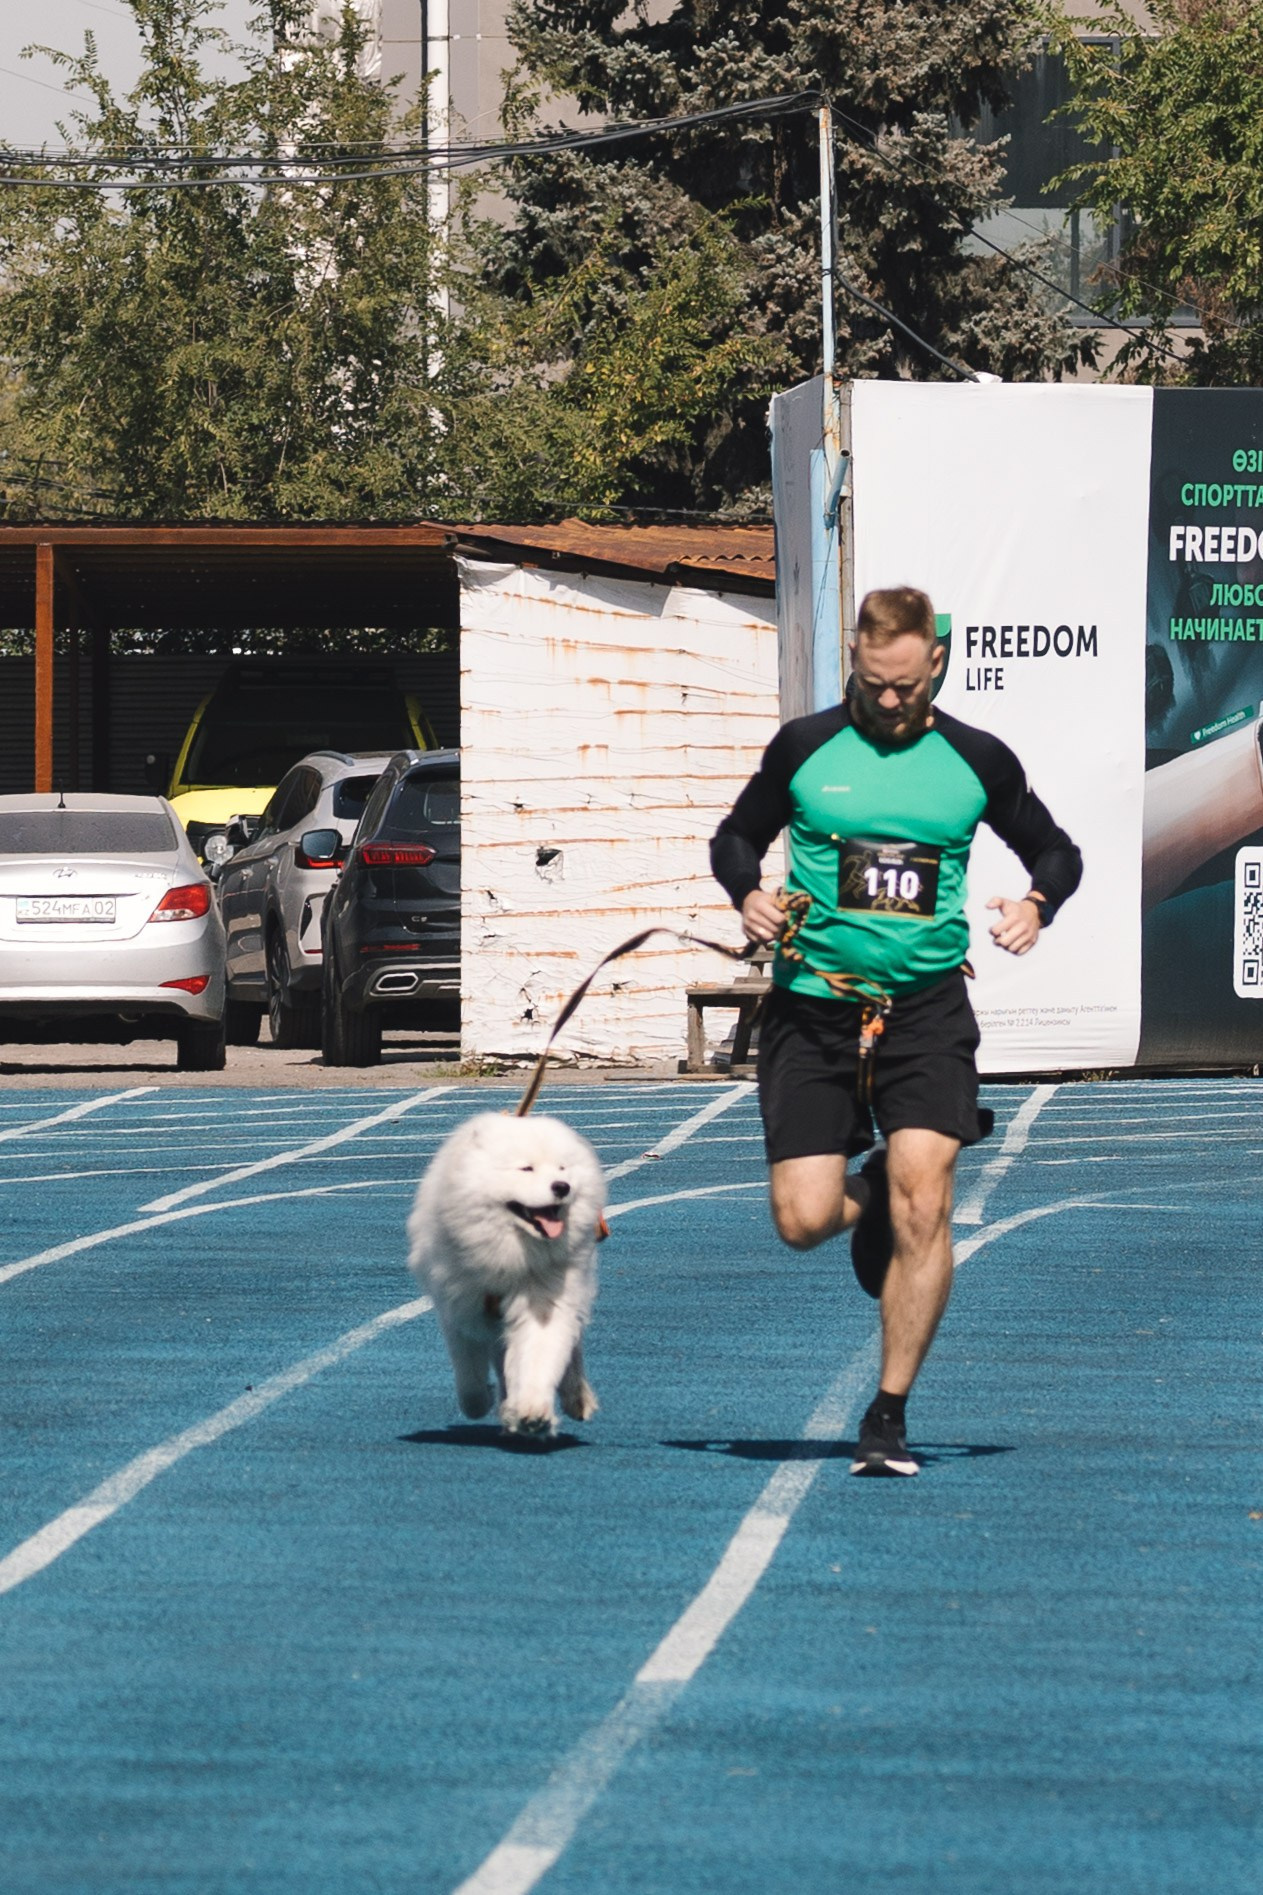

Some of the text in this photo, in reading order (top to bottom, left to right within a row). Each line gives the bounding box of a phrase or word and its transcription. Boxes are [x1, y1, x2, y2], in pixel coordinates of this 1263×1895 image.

[966, 624, 1098, 659] FREEDOM
[966, 667, 1004, 691] LIFE
[864, 867, 919, 900] 110
[95, 901, 114, 915] 02
